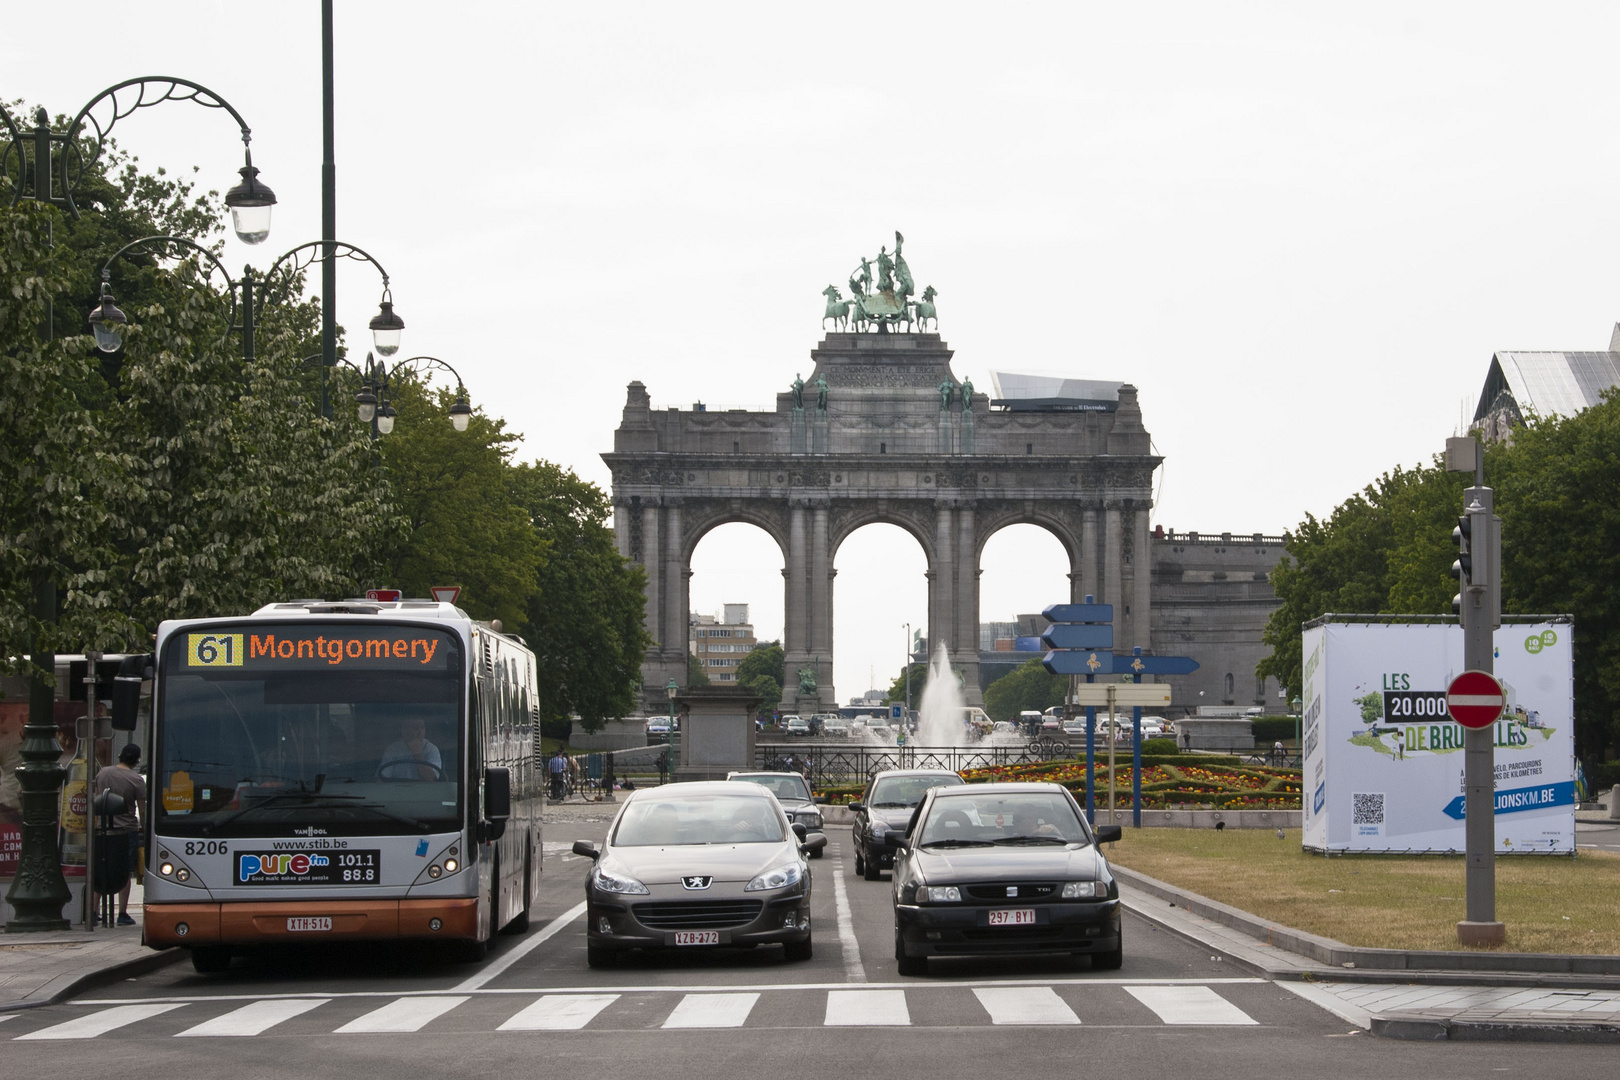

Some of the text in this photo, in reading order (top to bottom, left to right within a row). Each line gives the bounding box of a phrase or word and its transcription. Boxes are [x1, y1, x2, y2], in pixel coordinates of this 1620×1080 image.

[197, 635, 438, 665] 61 Montgomery
[1383, 673, 1410, 690] LES
[1391, 697, 1450, 716] 20.000.
[1405, 721, 1527, 751] DE BRULES
[1508, 759, 1542, 770] PARCOURONS
[1511, 767, 1543, 778] KILOMÈTRES
[67, 796, 87, 804] Hava
[3, 832, 21, 841] NAD
[4, 842, 22, 851] COM
[185, 841, 228, 856] 8206
[273, 838, 348, 850] www.stib.be
[338, 854, 374, 867] 101.1
[239, 854, 329, 882] pure fm
[343, 869, 375, 881] 88.8
